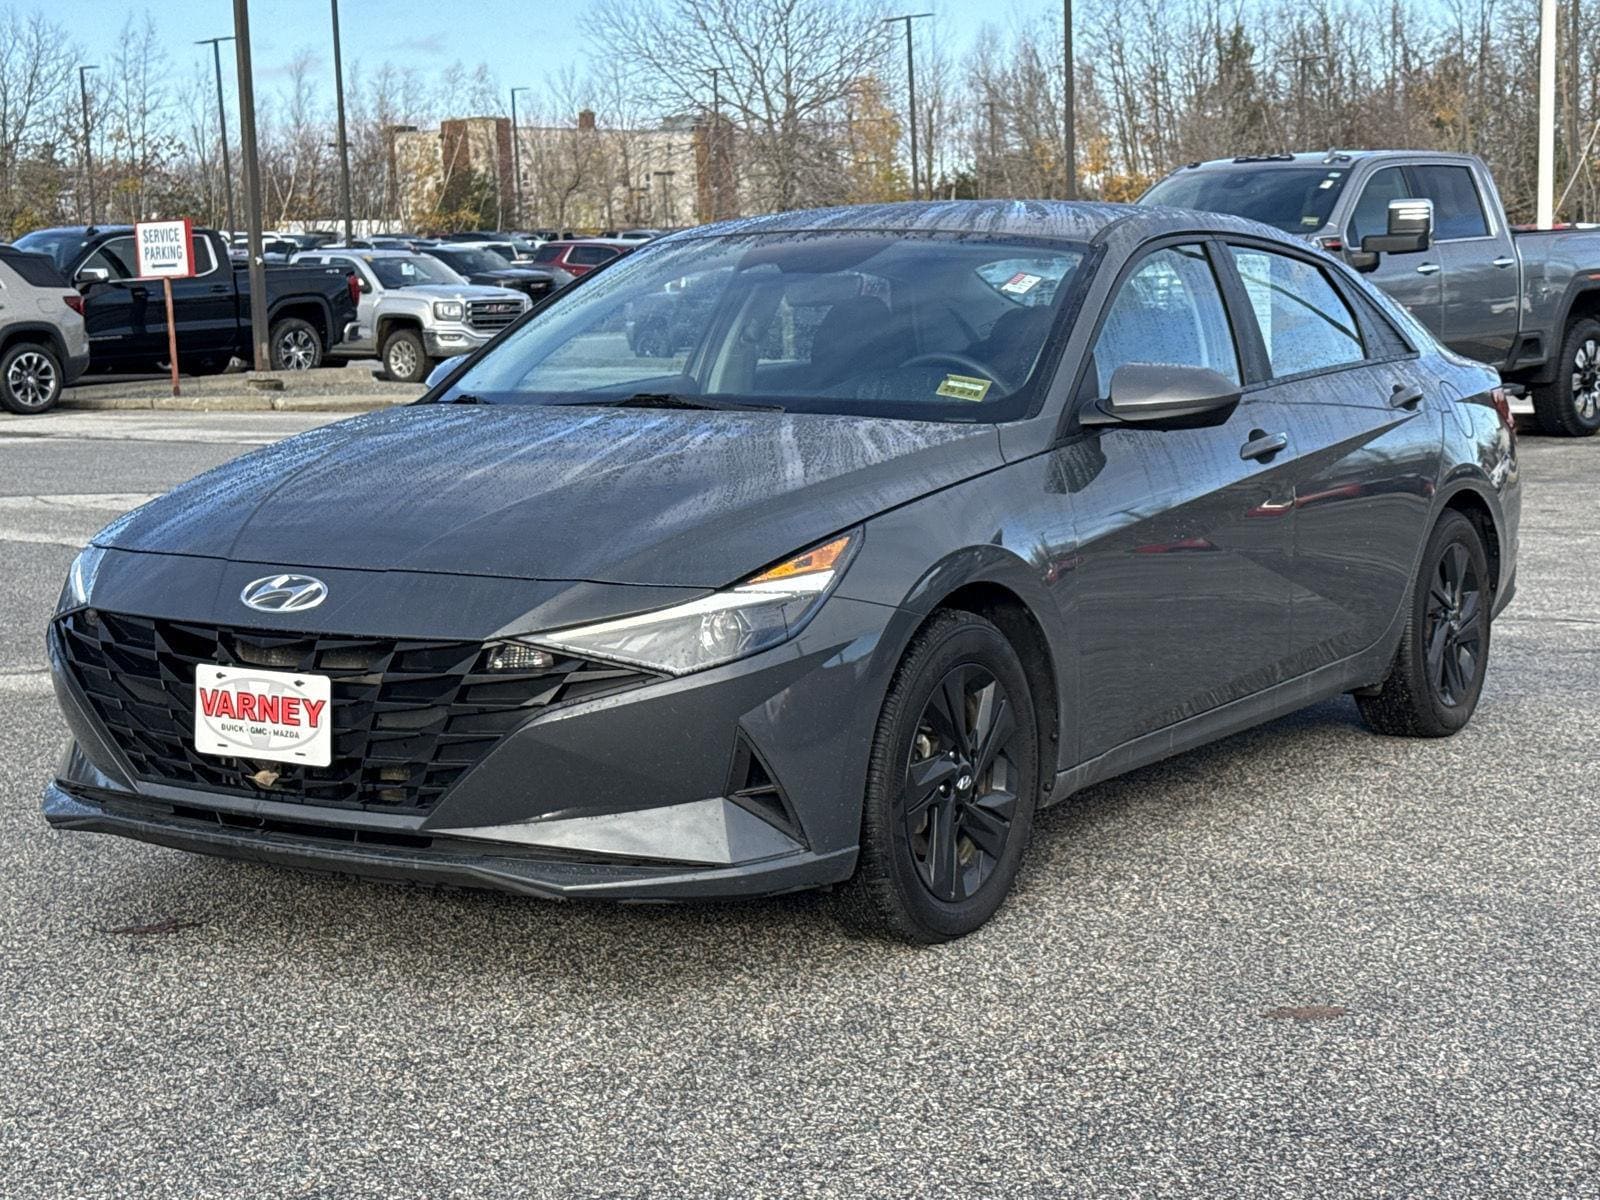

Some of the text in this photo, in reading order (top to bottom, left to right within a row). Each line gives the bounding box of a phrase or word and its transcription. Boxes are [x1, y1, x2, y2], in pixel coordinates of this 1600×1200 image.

[143, 228, 179, 243] SERVICE
[144, 245, 182, 260] PARKING
[199, 687, 327, 728] VARNEY
[221, 723, 300, 739] BUICK GMC MAZDA
